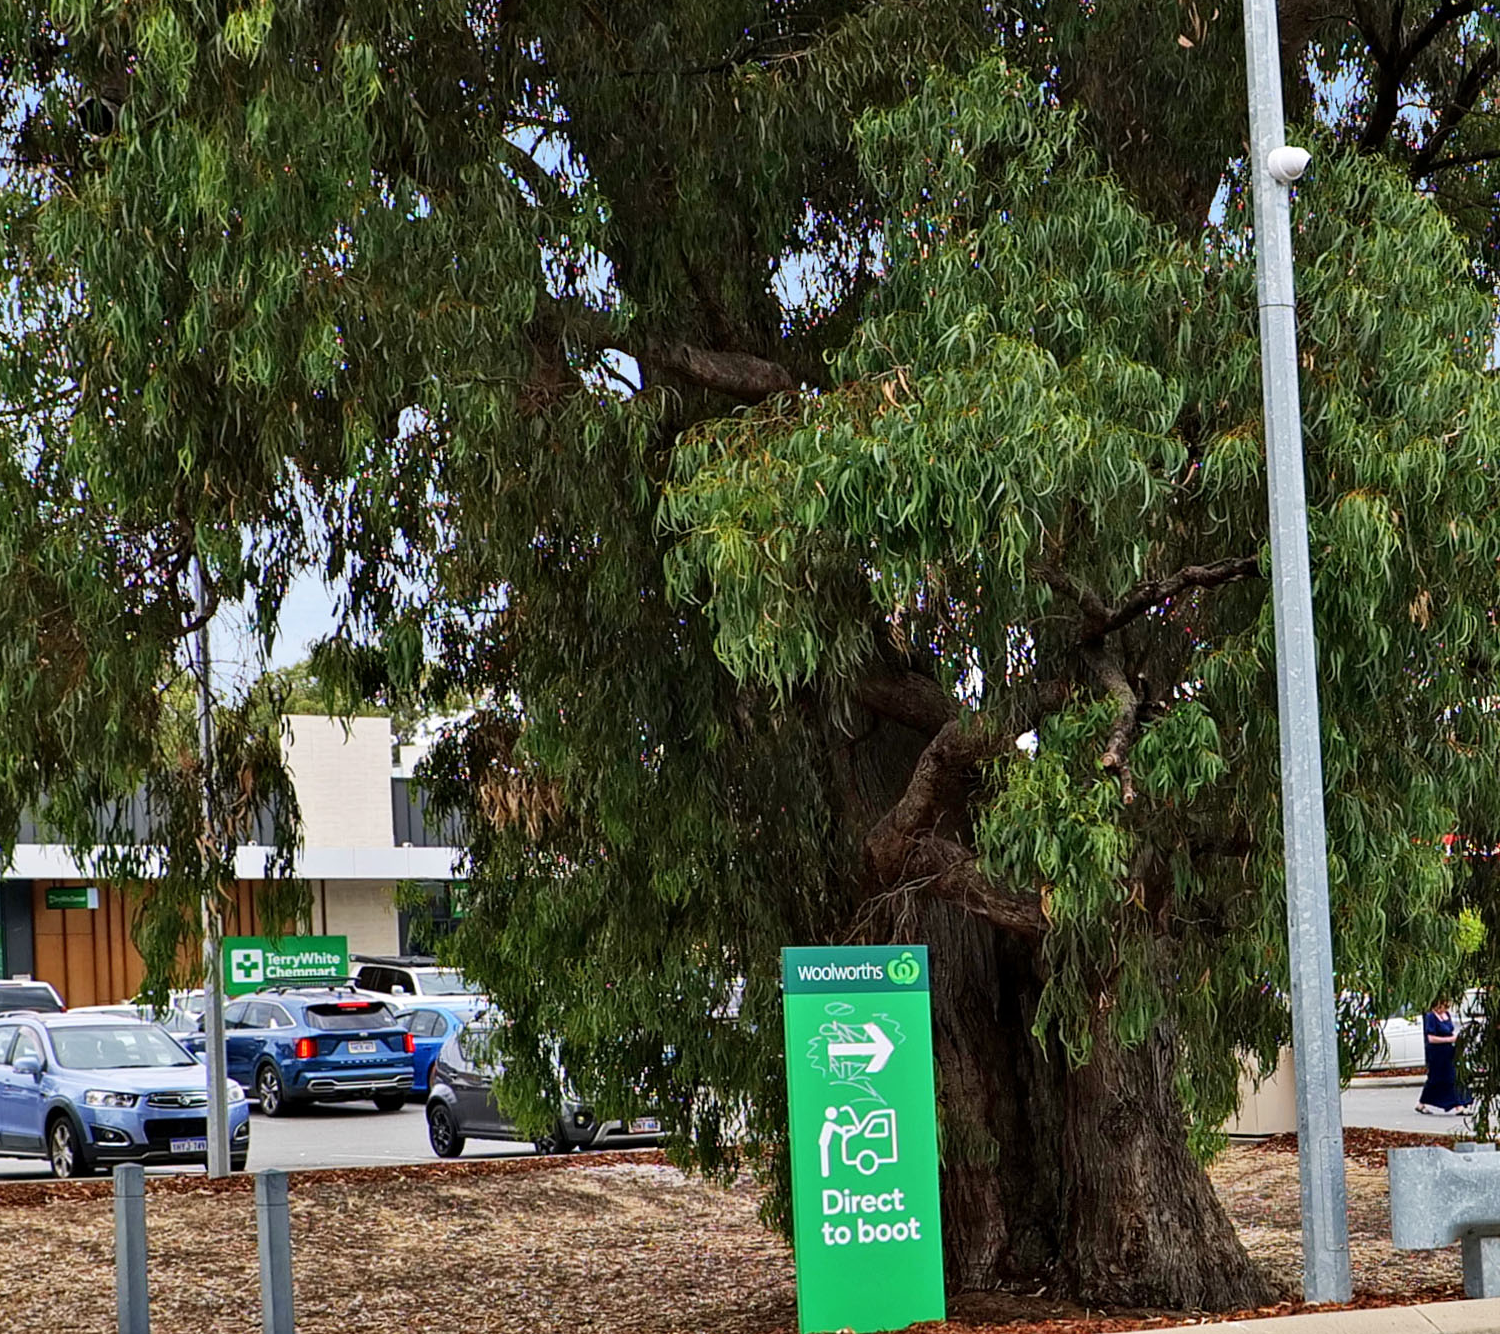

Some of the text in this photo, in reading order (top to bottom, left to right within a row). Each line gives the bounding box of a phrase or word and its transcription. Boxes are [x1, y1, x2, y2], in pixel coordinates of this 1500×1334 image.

[265, 952, 341, 968] TerryWhite
[265, 965, 337, 978] Chemmart
[797, 961, 884, 981] Woolworths
[822, 1187, 905, 1215] Direct
[821, 1216, 922, 1245] to boot
